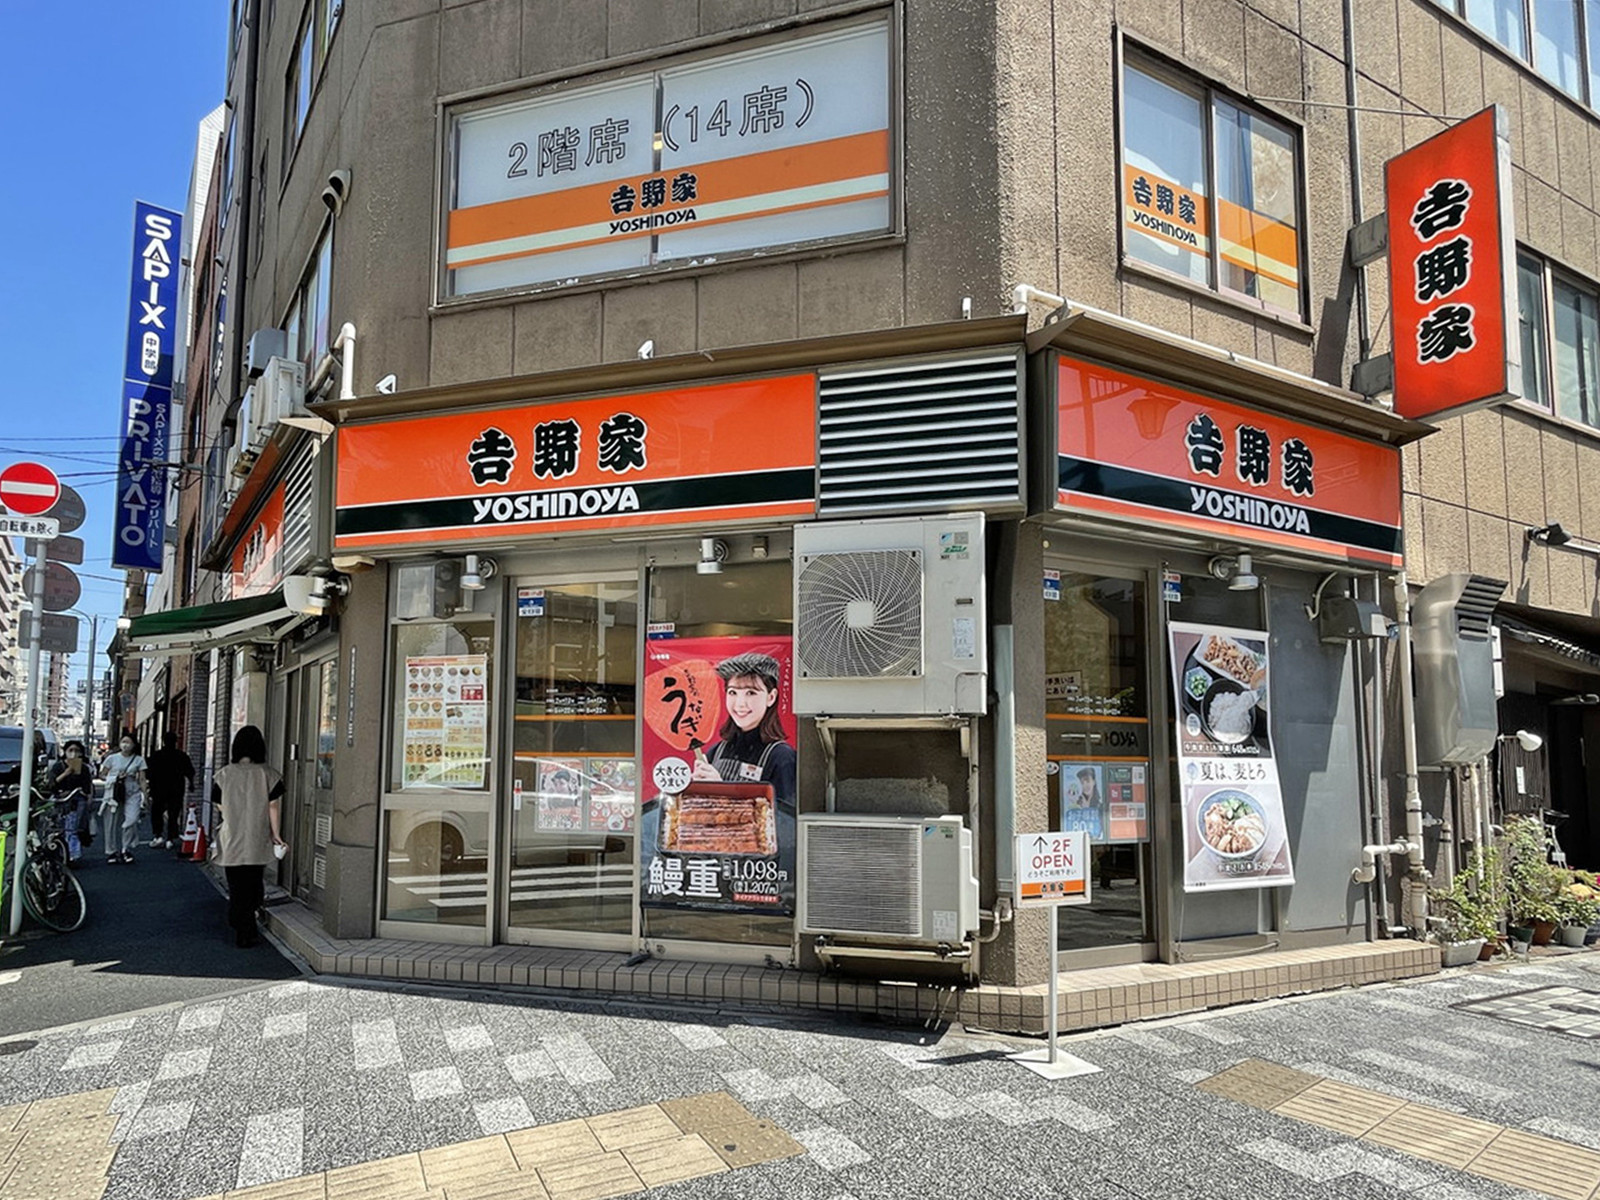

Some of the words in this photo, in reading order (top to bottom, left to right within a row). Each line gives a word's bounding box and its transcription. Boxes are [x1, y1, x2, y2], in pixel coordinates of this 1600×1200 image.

[507, 118, 629, 179] 2階席
[610, 172, 698, 214] 吉野家
[1132, 176, 1196, 225] 吉野家
[610, 208, 697, 235] YOSHINOYA
[1133, 209, 1197, 246] YOSHINOYA
[139, 214, 172, 329] SAPIX
[1410, 179, 1477, 364] 吉野家
[144, 337, 157, 370] 中学部
[467, 412, 648, 487] 吉野家
[1184, 413, 1316, 499] 吉野家
[121, 398, 152, 546] PRIVATO
[473, 486, 640, 523] YOSHINOYA
[1190, 486, 1311, 534] YOSHINOYA
[0, 520, 53, 535] 自転車を除く
[1045, 676, 1075, 687] 手洗いは
[661, 676, 703, 737] うなぎ
[656, 766, 688, 777] 大きくて
[660, 778, 685, 787] うまい
[1032, 854, 1073, 869] OPEN
[1052, 839, 1071, 852] 2F
[648, 857, 722, 898] 鰻重
